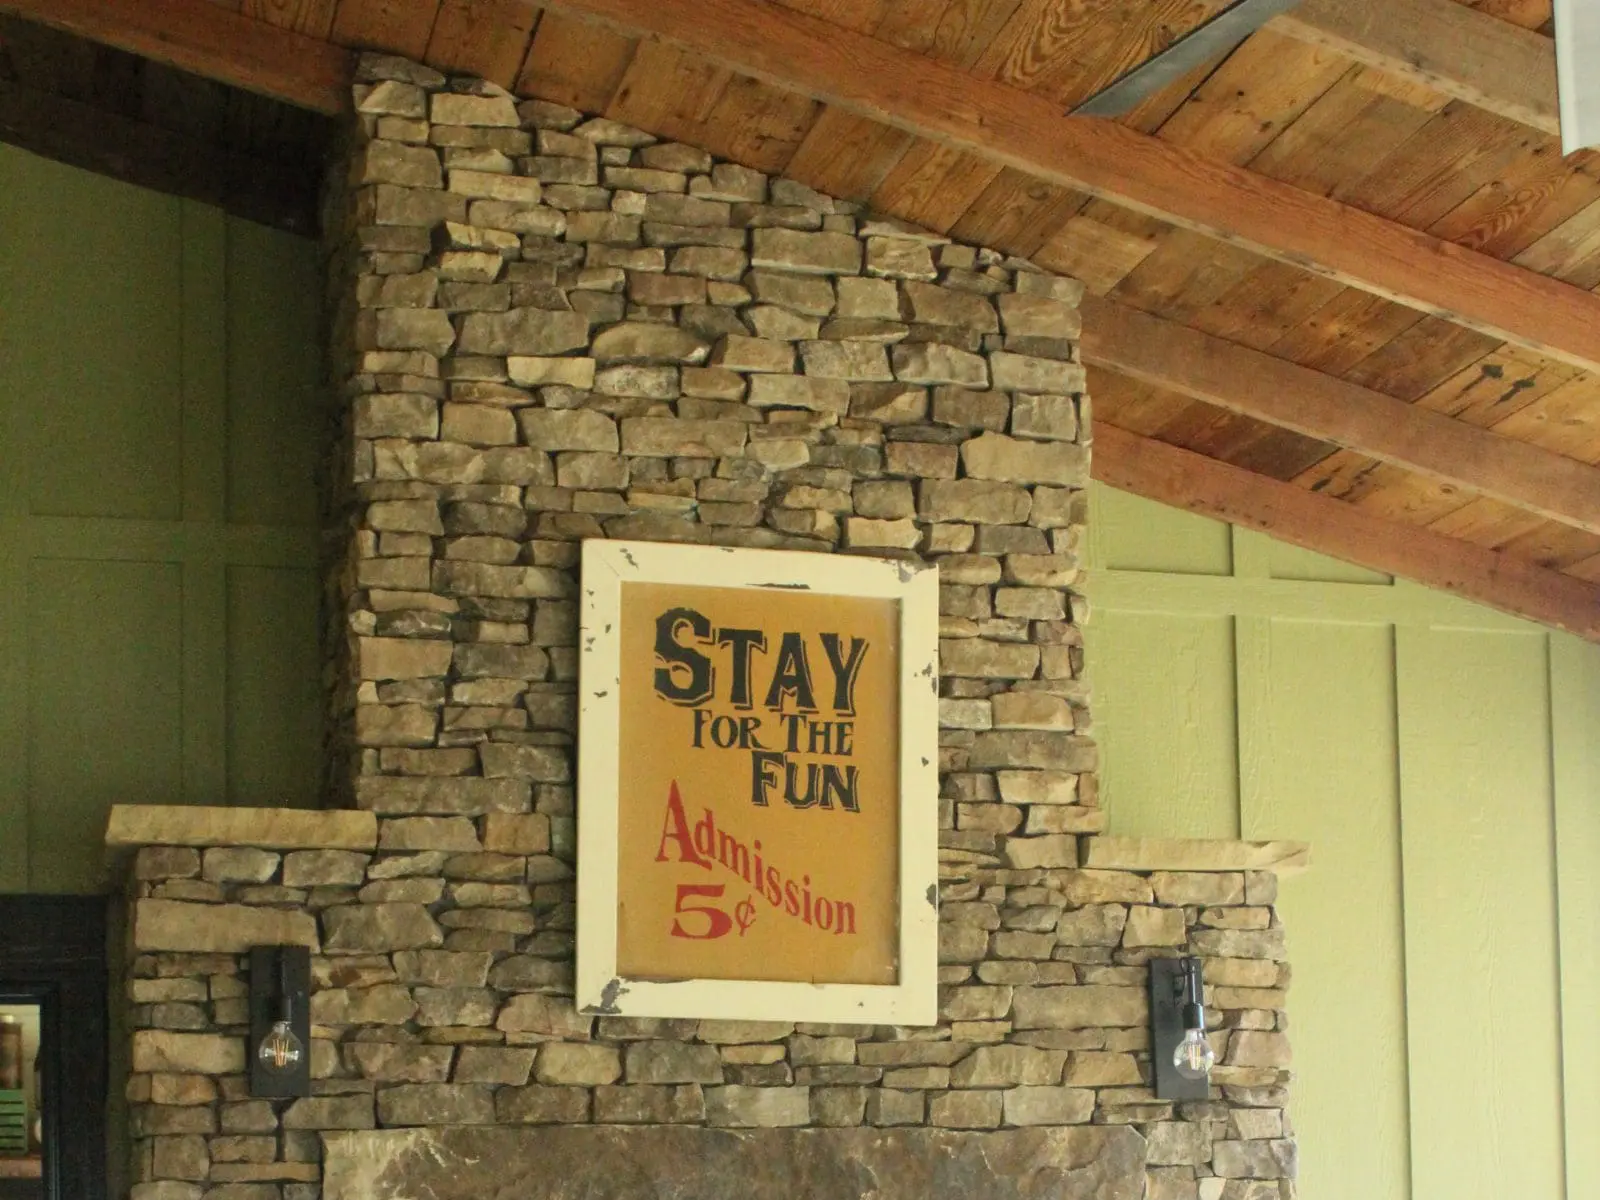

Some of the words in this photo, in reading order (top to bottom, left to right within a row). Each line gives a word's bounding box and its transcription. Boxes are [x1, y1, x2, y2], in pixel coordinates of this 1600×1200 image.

[654, 607, 869, 717] STAY
[692, 709, 771, 750] FOR
[780, 714, 854, 756] THE
[751, 751, 860, 813] FUN
[655, 778, 857, 935] Admission
[671, 884, 756, 939] 5¢
